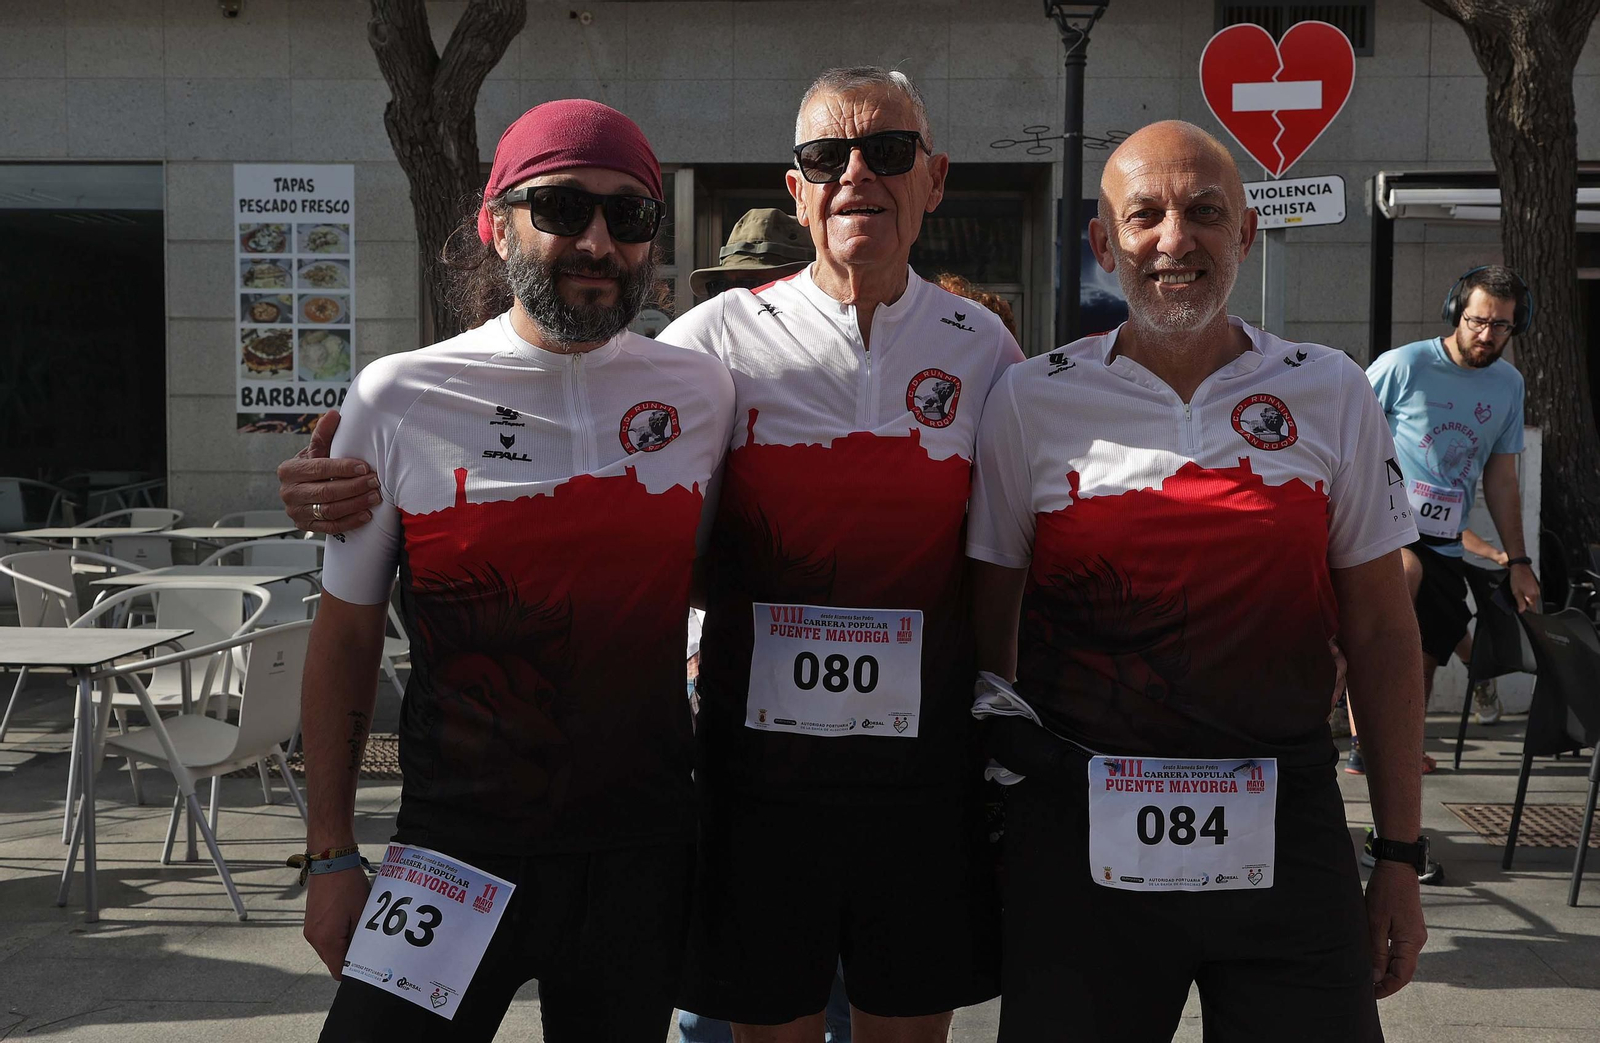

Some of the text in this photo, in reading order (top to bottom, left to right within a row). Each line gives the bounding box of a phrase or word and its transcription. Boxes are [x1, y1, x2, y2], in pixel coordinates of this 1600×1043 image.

[273, 177, 315, 193] TAPAS
[1248, 182, 1333, 200] VIOLENCIA
[239, 198, 350, 214] PESCADO FRESCO
[1253, 201, 1316, 217] ACHISTA
[940, 318, 976, 332] SPALL
[922, 369, 961, 398] RUNNING
[241, 386, 348, 408] BARBACOA
[634, 403, 678, 425] RUNNING
[1251, 395, 1295, 428] RUNNING
[1433, 421, 1478, 444] CARRERA
[1263, 435, 1298, 449] ROQU
[482, 450, 532, 462] SPALL
[1420, 502, 1451, 522] 021
[769, 605, 804, 624] VIII
[899, 616, 912, 631] 11
[803, 618, 888, 630] CARRERA POPULAR
[770, 623, 890, 644] PUENTE MAYORGA
[793, 651, 879, 694] 080
[1143, 771, 1236, 779] CARRERA POPULAR
[1246, 780, 1265, 788] MAYO
[1105, 778, 1239, 794] PUENTE MAYORGA
[1136, 805, 1229, 846] 084
[399, 857, 470, 889] CARRERA POPULAR
[378, 864, 468, 904] PUENTE MAYORGA
[481, 883, 499, 901] 11
[475, 895, 494, 909] MAYO
[364, 890, 443, 948] 263
